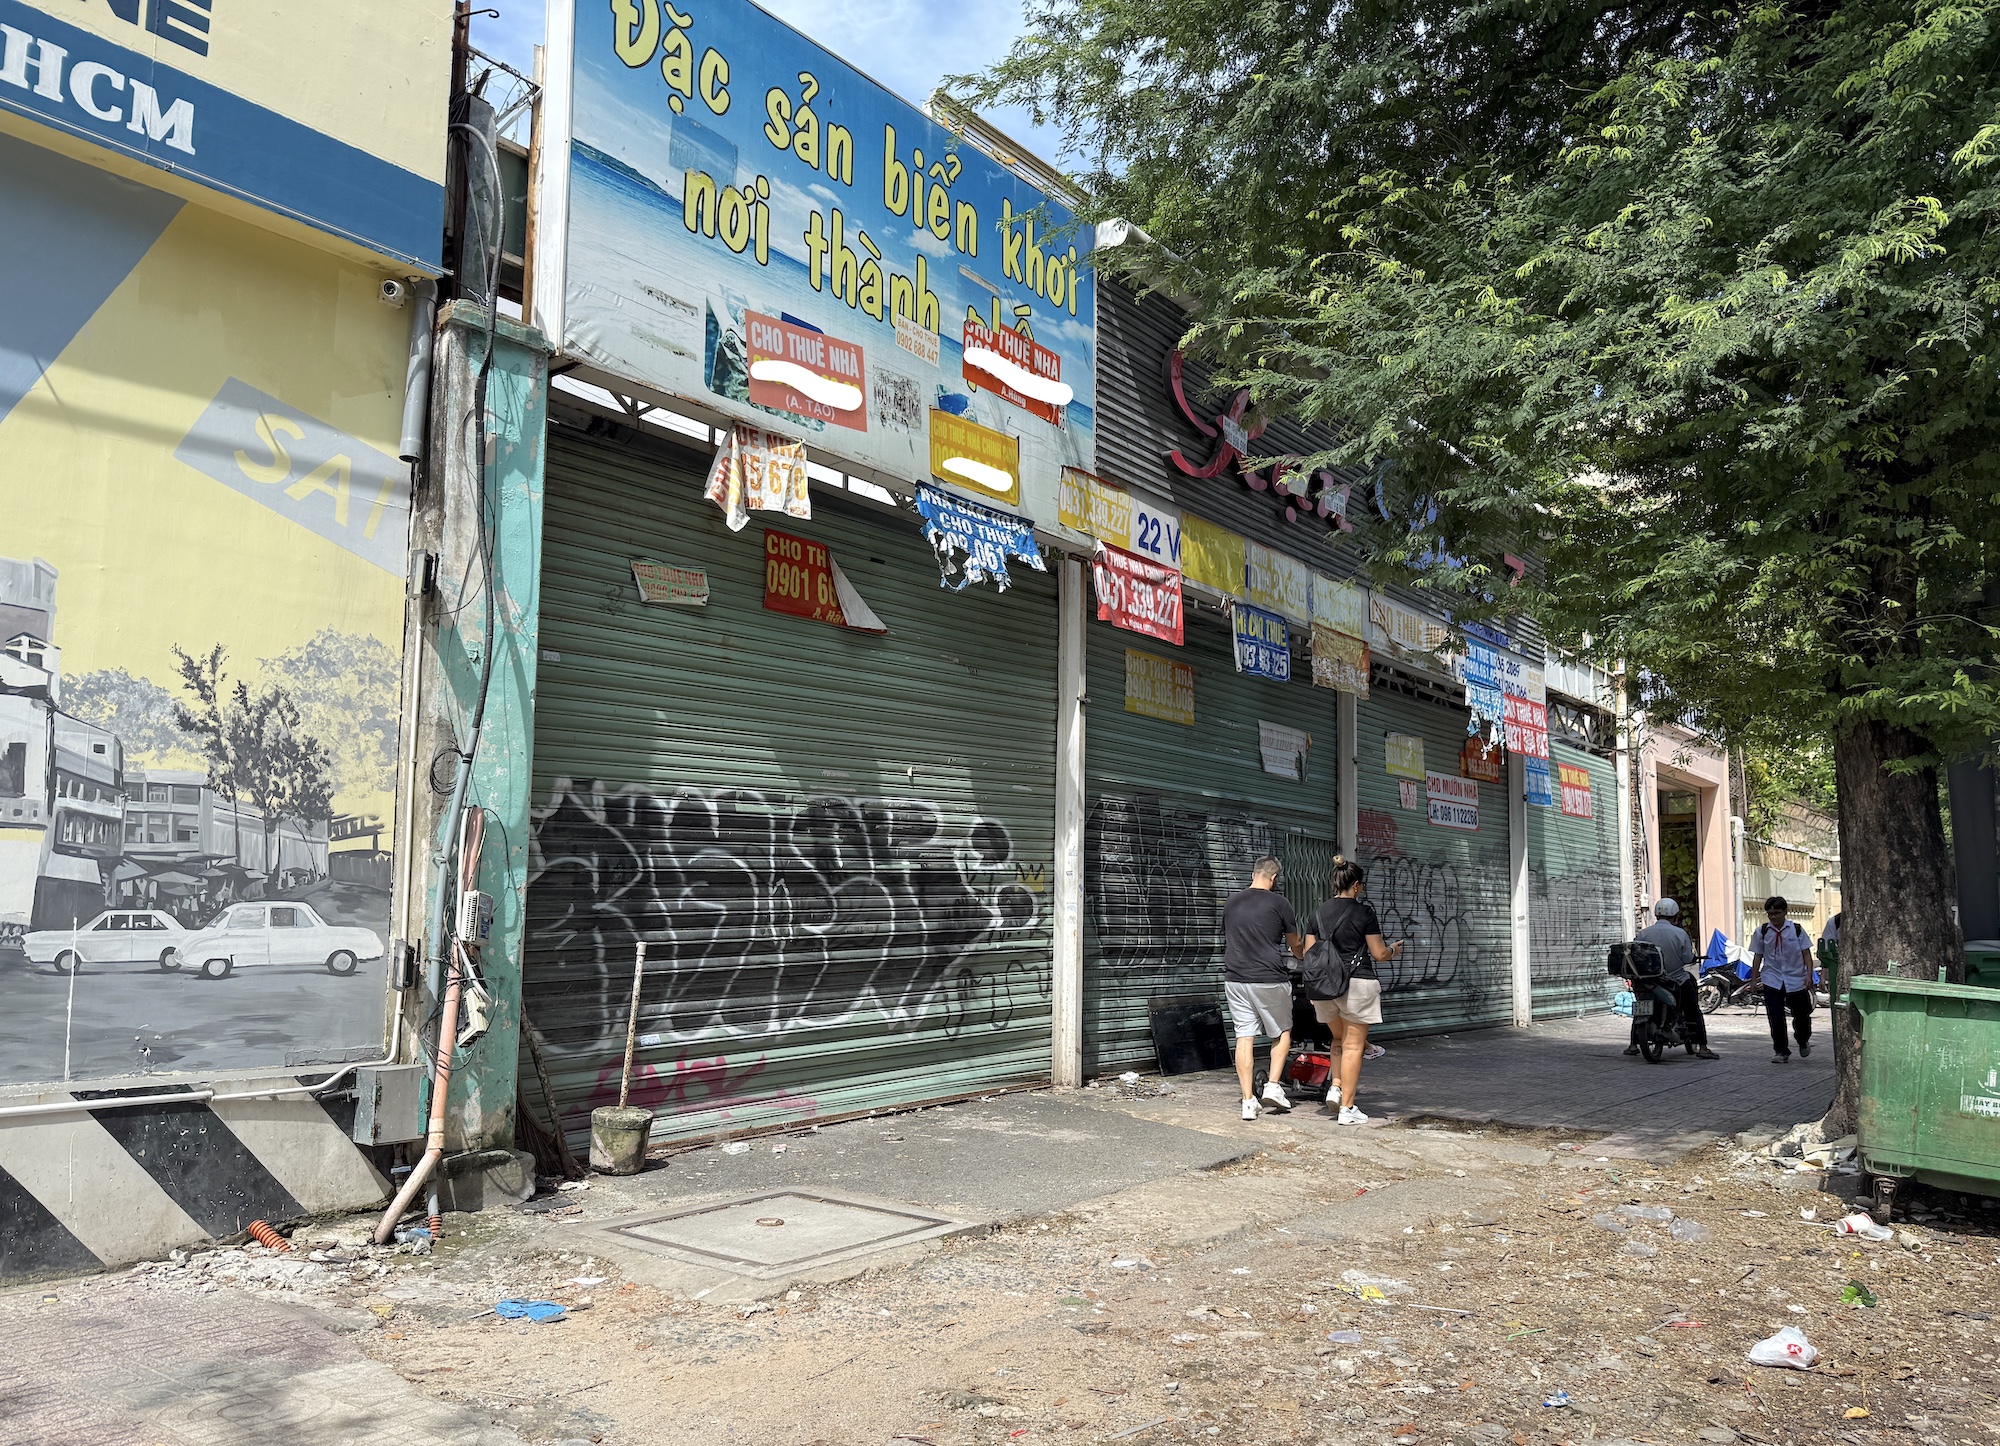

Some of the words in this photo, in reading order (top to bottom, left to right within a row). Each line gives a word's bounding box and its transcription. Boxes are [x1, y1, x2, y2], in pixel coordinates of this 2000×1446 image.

[0, 22, 196, 156] HCM
[764, 71, 853, 186] sản
[884, 123, 978, 258] biển
[683, 167, 770, 265] nơi
[750, 320, 784, 355] CHO
[786, 336, 826, 369] THUÊ
[828, 346, 860, 379] NHÀ
[896, 330, 912, 352] 0902
[926, 347, 939, 365] 447
[998, 328, 1031, 366] THUÊ
[1033, 347, 1060, 381] NHÀ
[933, 418, 947, 440] CHO
[767, 534, 802, 561] CHO
[939, 512, 972, 536] CHO
[975, 523, 1017, 550] THUÊ
[1138, 512, 1162, 555] 22
[766, 559, 810, 602] 0901
[1126, 653, 1147, 676] CHO
[1175, 667, 1194, 689] NHÀ
[1427, 775, 1441, 794] CHO
[1463, 781, 1478, 800] NHÀ
[1440, 805, 1452, 822] 096
